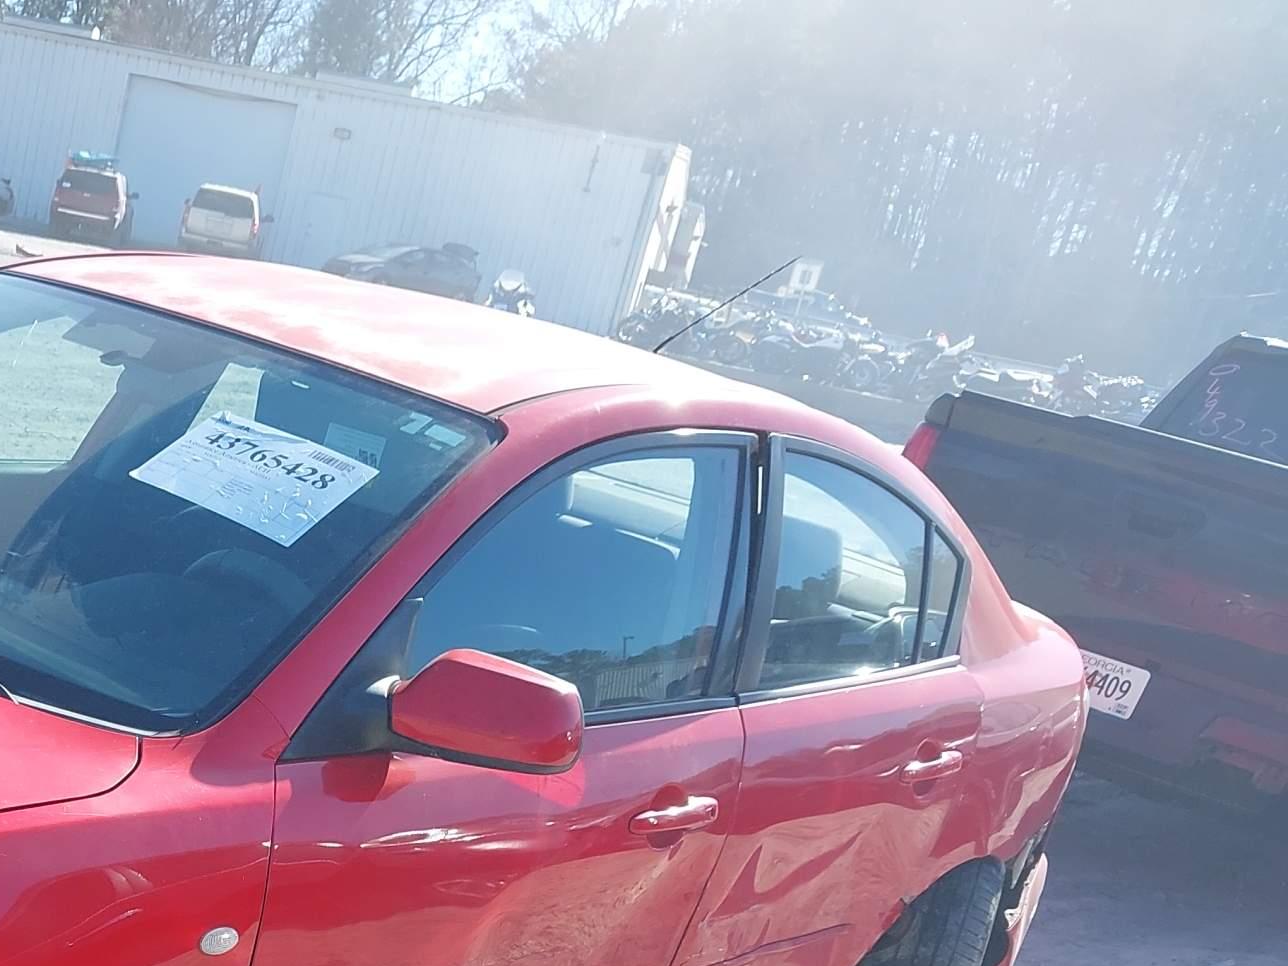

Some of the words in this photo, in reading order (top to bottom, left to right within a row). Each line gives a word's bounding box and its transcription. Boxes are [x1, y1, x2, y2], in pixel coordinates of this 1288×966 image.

[205, 431, 336, 490] 43765428
[1082, 654, 1125, 676] EORGIA
[1084, 669, 1132, 701] 4409
